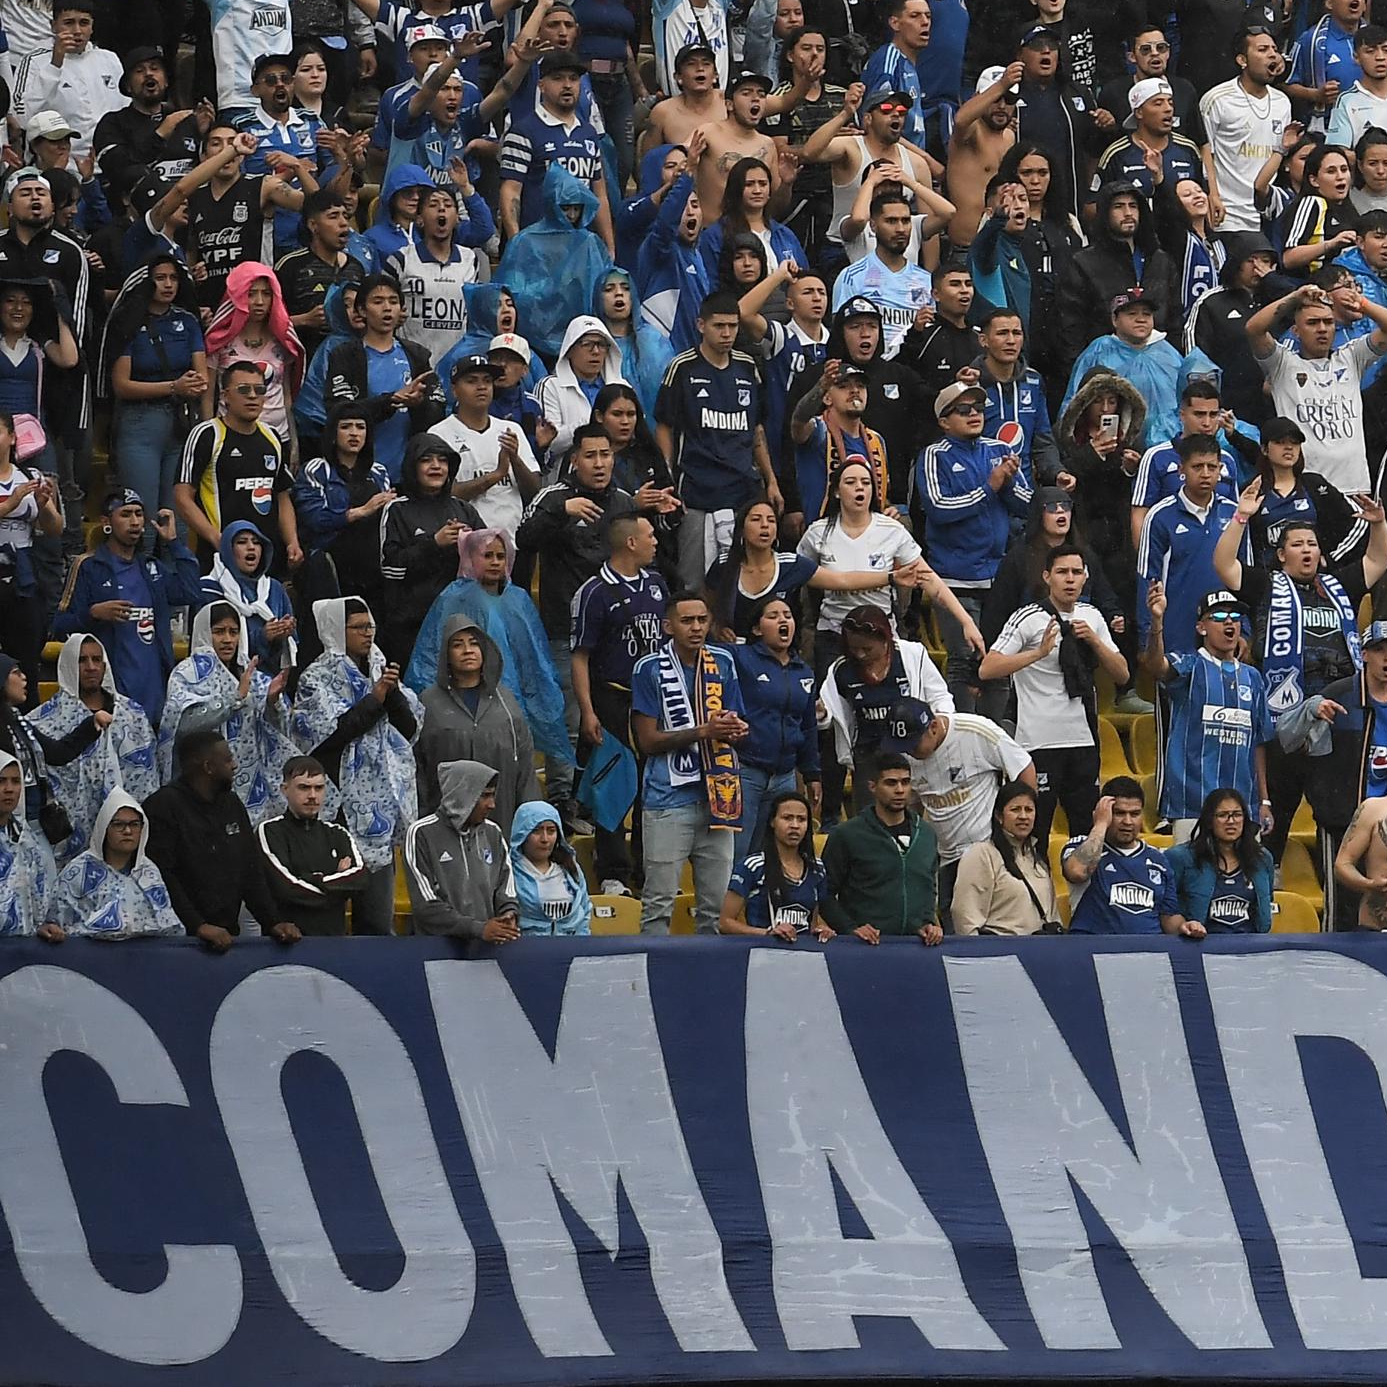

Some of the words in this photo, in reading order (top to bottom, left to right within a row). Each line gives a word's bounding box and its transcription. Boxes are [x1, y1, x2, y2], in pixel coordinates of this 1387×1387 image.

[202, 247, 243, 263] YPF
[882, 307, 919, 325] NDIN
[700, 408, 750, 431] ANDINA
[1312, 423, 1353, 441] ORO
[235, 477, 275, 491] PEPSI
[1302, 609, 1341, 629] NDINA
[1110, 884, 1154, 907] ANDINA
[1211, 900, 1250, 920] ANDINA
